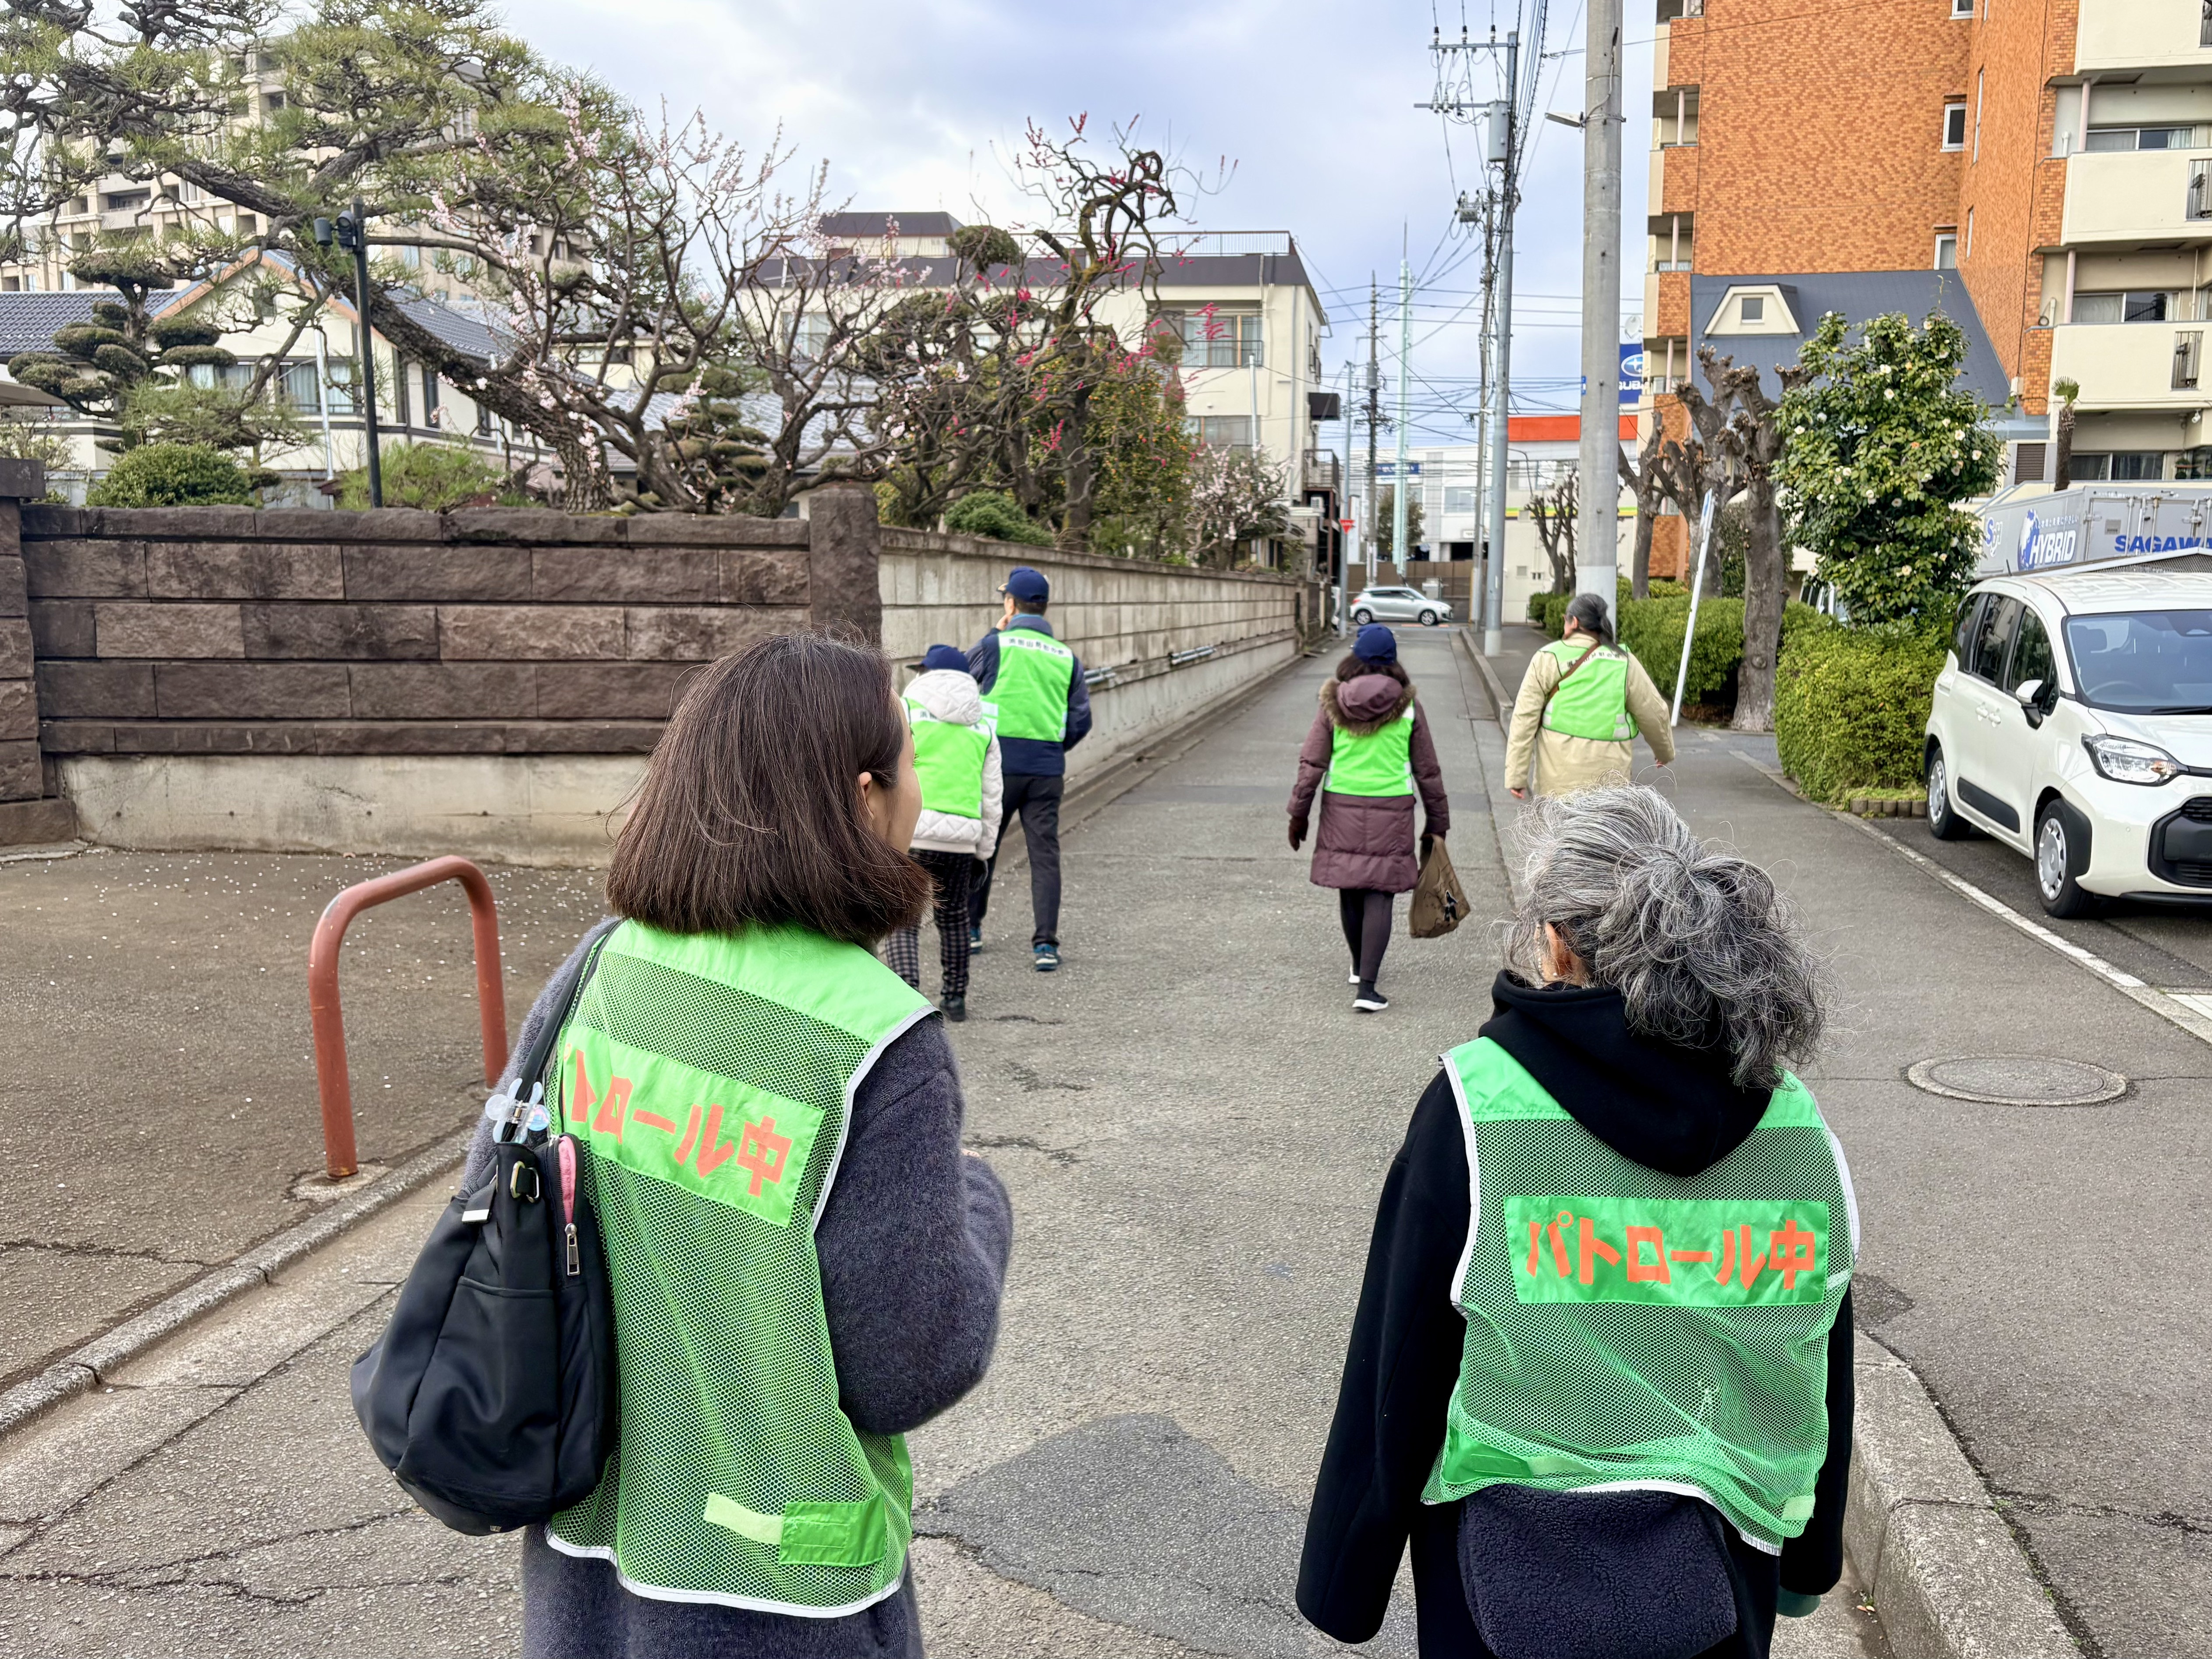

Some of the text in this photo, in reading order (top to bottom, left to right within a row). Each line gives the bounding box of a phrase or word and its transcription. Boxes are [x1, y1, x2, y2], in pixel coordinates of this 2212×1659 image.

[2029, 530, 2076, 565] HYBRID
[563, 1043, 792, 1198] トロール中
[1526, 1210, 1815, 1290] パトロール中
